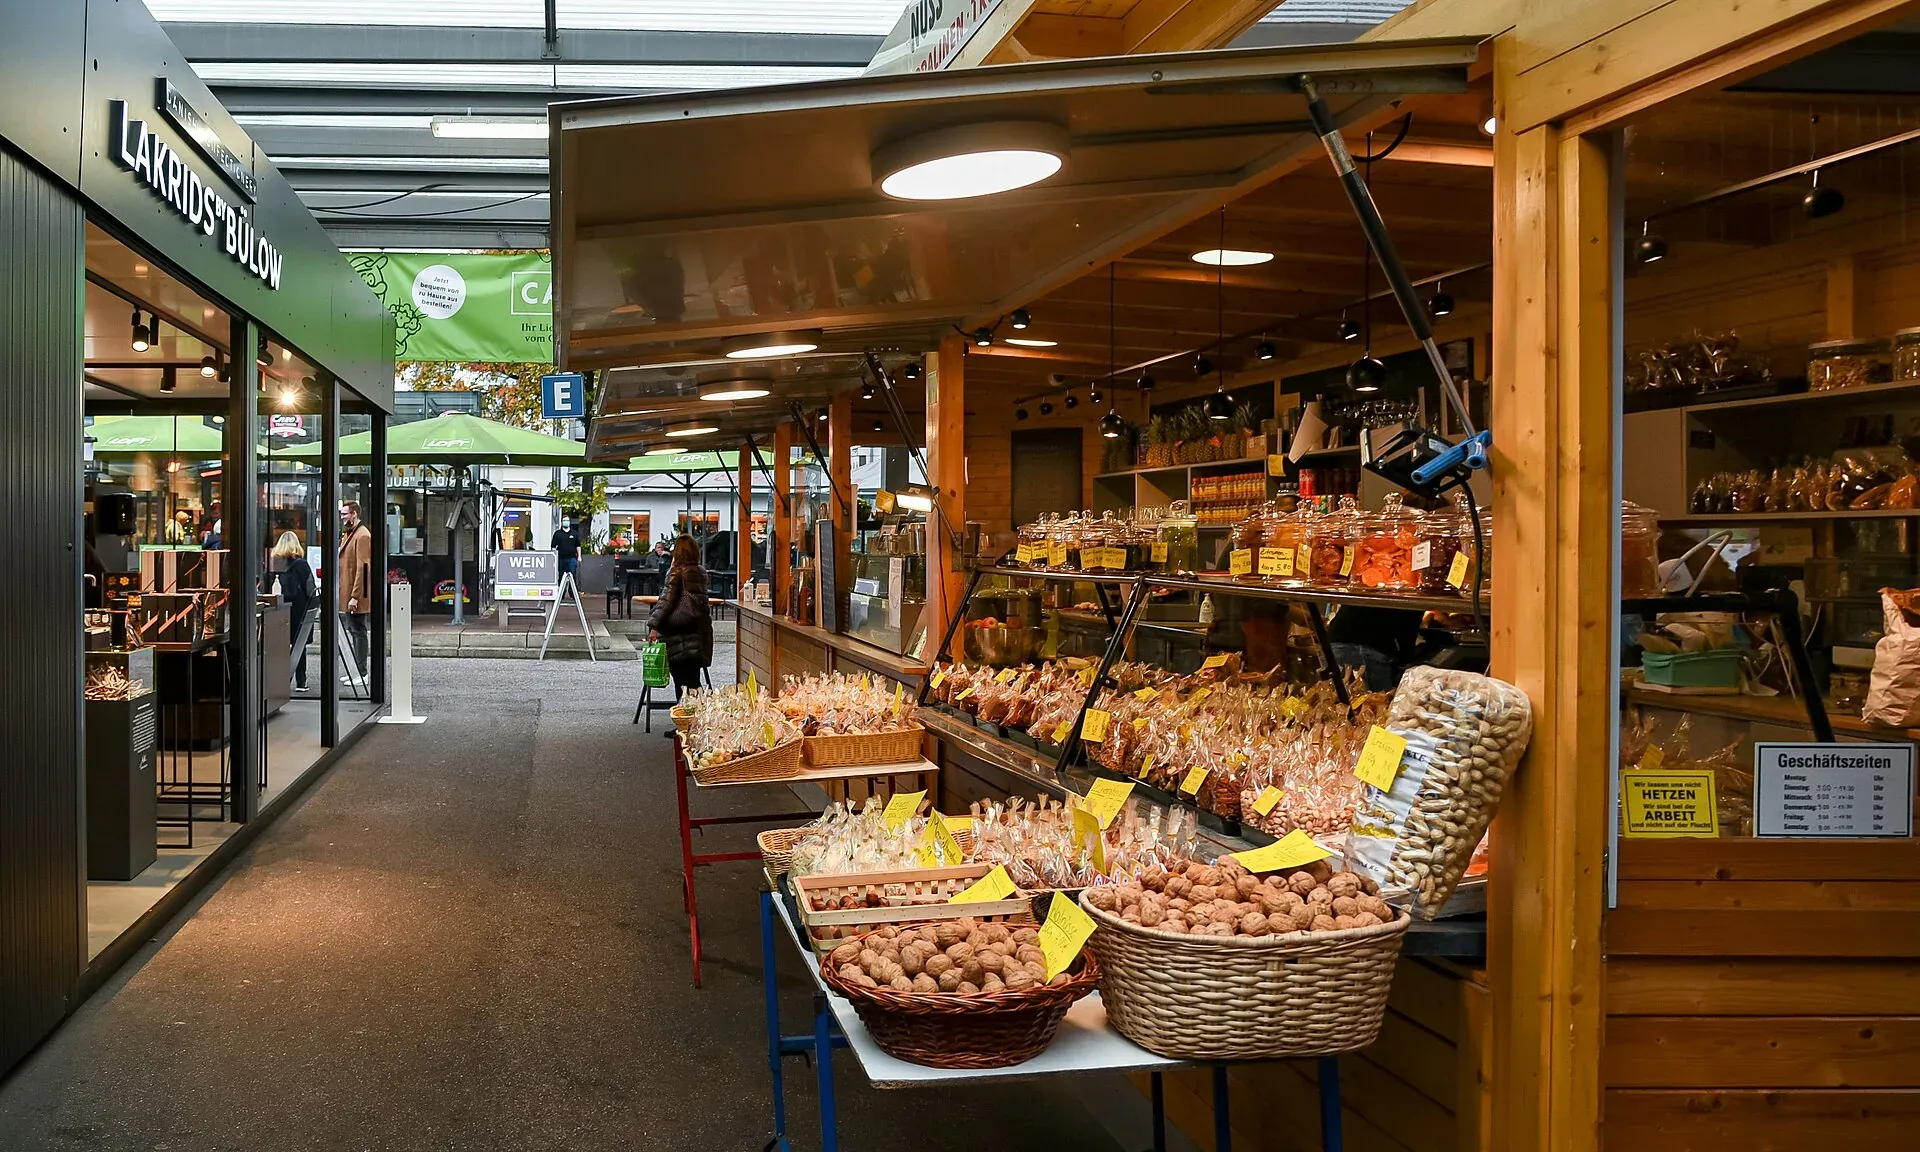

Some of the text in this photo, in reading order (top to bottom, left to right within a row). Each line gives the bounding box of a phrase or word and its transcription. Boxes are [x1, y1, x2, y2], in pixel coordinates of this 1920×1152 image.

[121, 99, 282, 291] LAKRIDS BY BÜLOW
[420, 282, 446, 292] bequem
[427, 291, 446, 299] Hause
[421, 299, 453, 309] bestellen!
[521, 323, 536, 331] Ihr
[554, 381, 571, 410] E
[427, 440, 469, 448] LOFT
[509, 556, 545, 568] WEIN
[518, 571, 536, 579] BAR
[1778, 753, 1891, 768] Geschäftszeiten
[1642, 790, 1695, 799] HETZEN
[1644, 811, 1696, 820] ARBEIT
